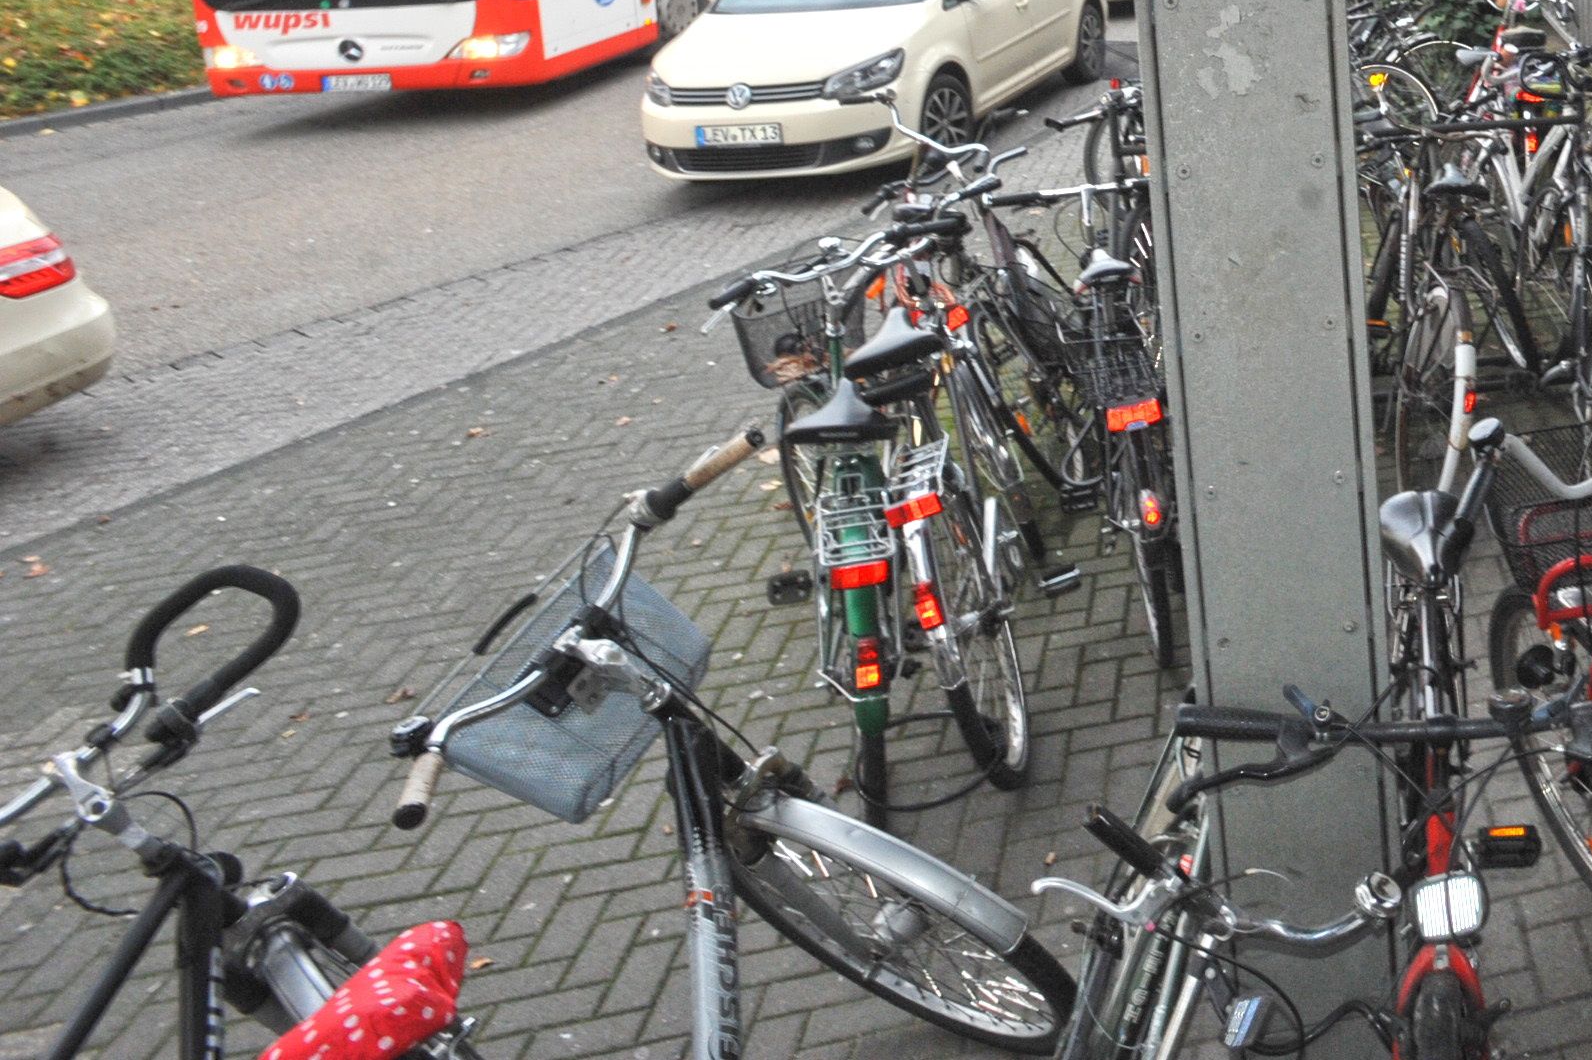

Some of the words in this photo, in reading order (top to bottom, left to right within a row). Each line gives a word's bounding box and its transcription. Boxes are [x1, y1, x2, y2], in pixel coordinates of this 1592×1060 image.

[233, 11, 332, 35] wupsi
[703, 128, 730, 143] LEV
[738, 126, 757, 141] TX
[760, 125, 778, 140] 13
